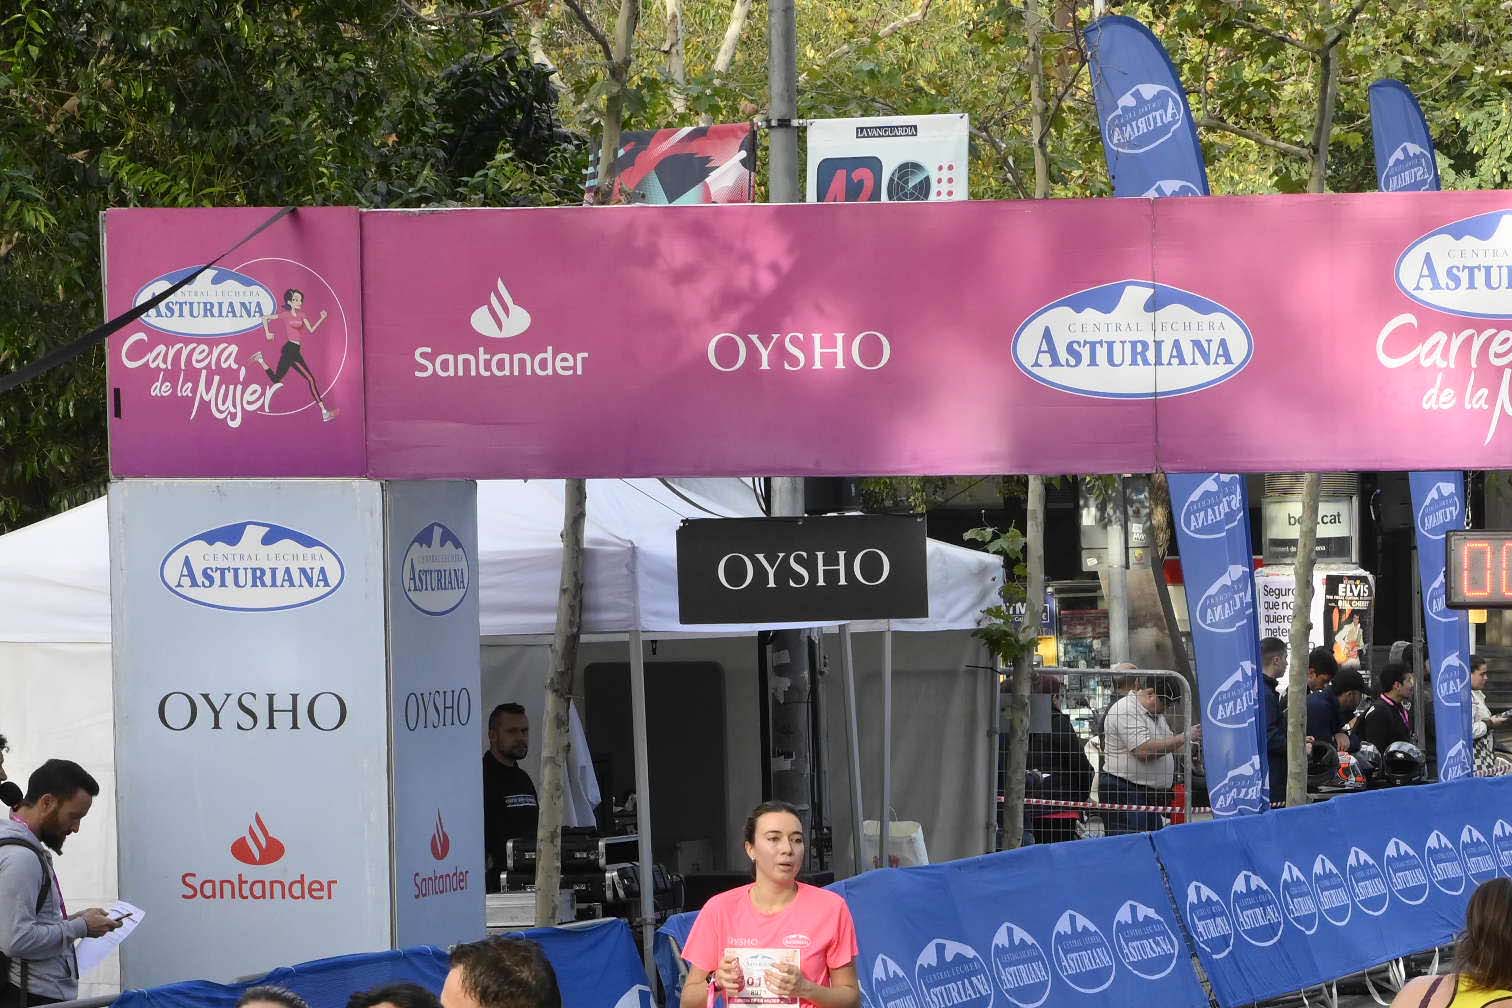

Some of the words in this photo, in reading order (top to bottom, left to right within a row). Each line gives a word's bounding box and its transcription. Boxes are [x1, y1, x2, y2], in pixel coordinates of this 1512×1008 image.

[174, 290, 212, 298] ENTRAL
[215, 289, 261, 297] LECHERA
[1068, 322, 1144, 333] CENTRAL
[1151, 320, 1227, 331] LECHERA
[121, 332, 245, 371] Carrera
[413, 346, 589, 377] Santander
[707, 331, 891, 371] OYSHO
[1031, 325, 1234, 368] ASTURIANA
[150, 374, 174, 397] de
[176, 373, 194, 397] la
[189, 366, 284, 428] Mujer
[1422, 372, 1458, 411] de
[1464, 371, 1489, 410] la
[176, 554, 331, 589] ASTURIANA
[203, 553, 261, 562] CENTRAL
[266, 553, 325, 561] LECHERA
[408, 557, 466, 592] ASTURIANA
[717, 549, 891, 590] OYSHO
[1263, 601, 1280, 611] que
[1338, 584, 1369, 597] ELVIS
[157, 691, 348, 732] OYSHO
[404, 687, 471, 732] OYSHO
[181, 872, 338, 901] Santander
[413, 868, 469, 900] Santander
[997, 957, 1049, 990] ASTURIANA
[1057, 943, 1113, 976] ASTURIANA
